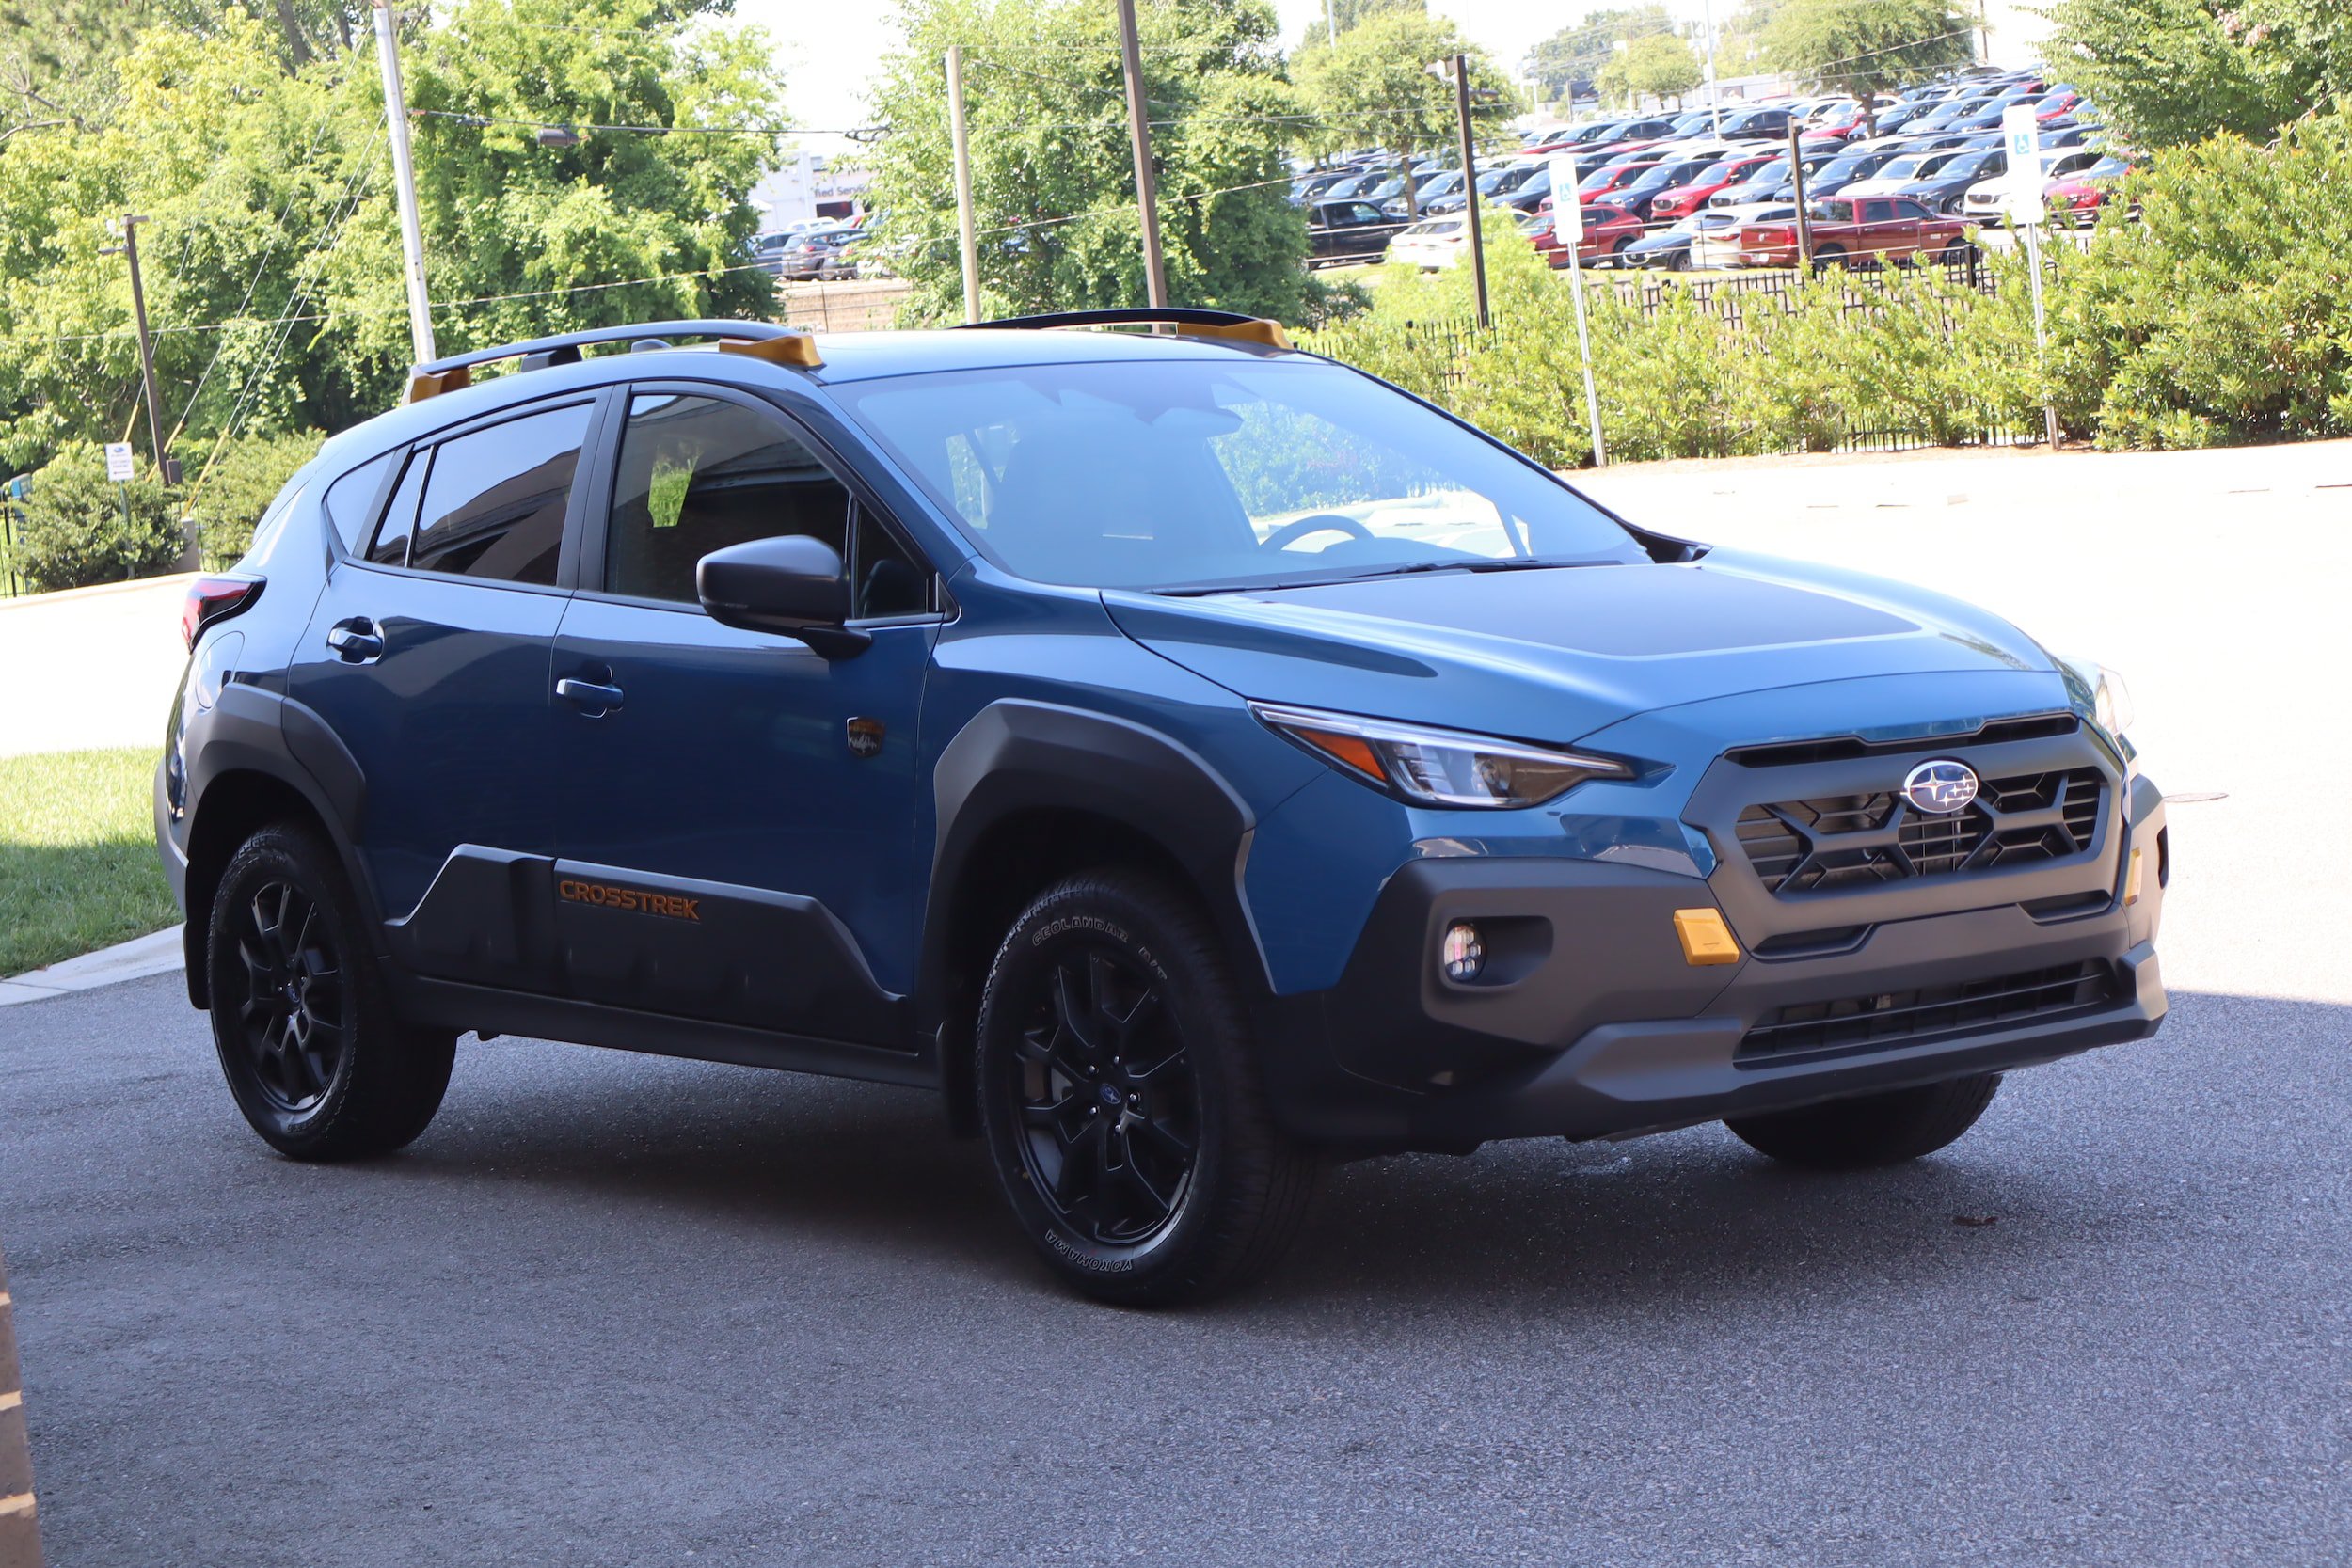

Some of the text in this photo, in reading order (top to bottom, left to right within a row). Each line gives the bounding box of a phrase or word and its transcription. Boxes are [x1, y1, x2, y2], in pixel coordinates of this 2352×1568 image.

[559, 880, 701, 921] CROSSTREK
[1031, 915, 1130, 947] GEOLANDAR
[1044, 1227, 1133, 1273] YOKOHAMA
